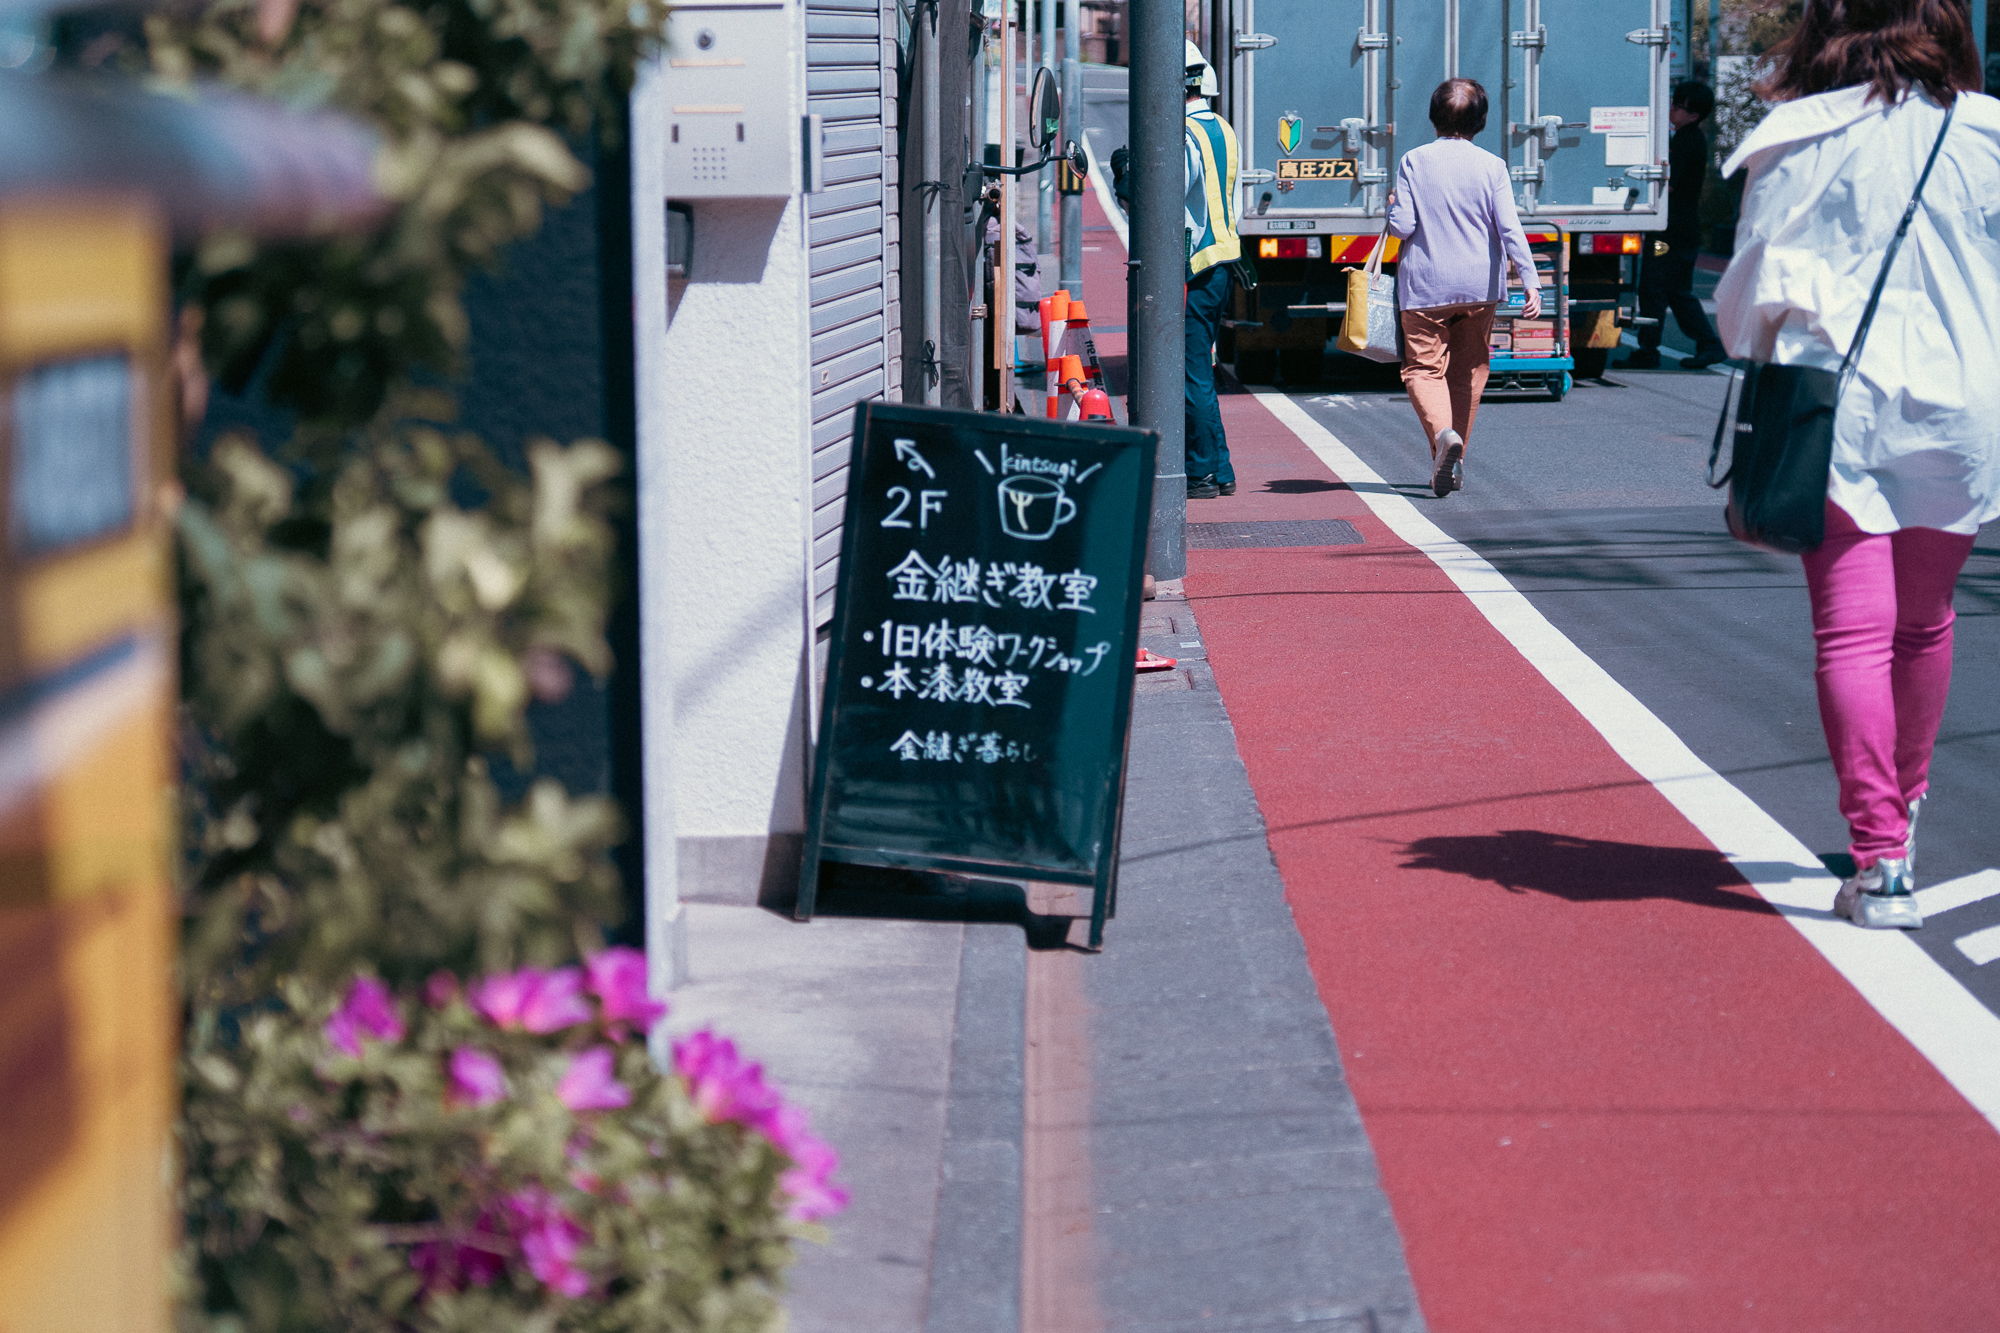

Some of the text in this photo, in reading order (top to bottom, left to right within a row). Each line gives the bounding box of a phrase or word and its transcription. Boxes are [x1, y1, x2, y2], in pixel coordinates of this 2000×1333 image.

[1280, 161, 1354, 178] 高圧ガス
[1001, 443, 1078, 484] kintsugi
[880, 485, 948, 530] 2F
[886, 549, 1098, 614] 金継ぎ教室
[889, 729, 1037, 764] 金継ぎ暮らし
